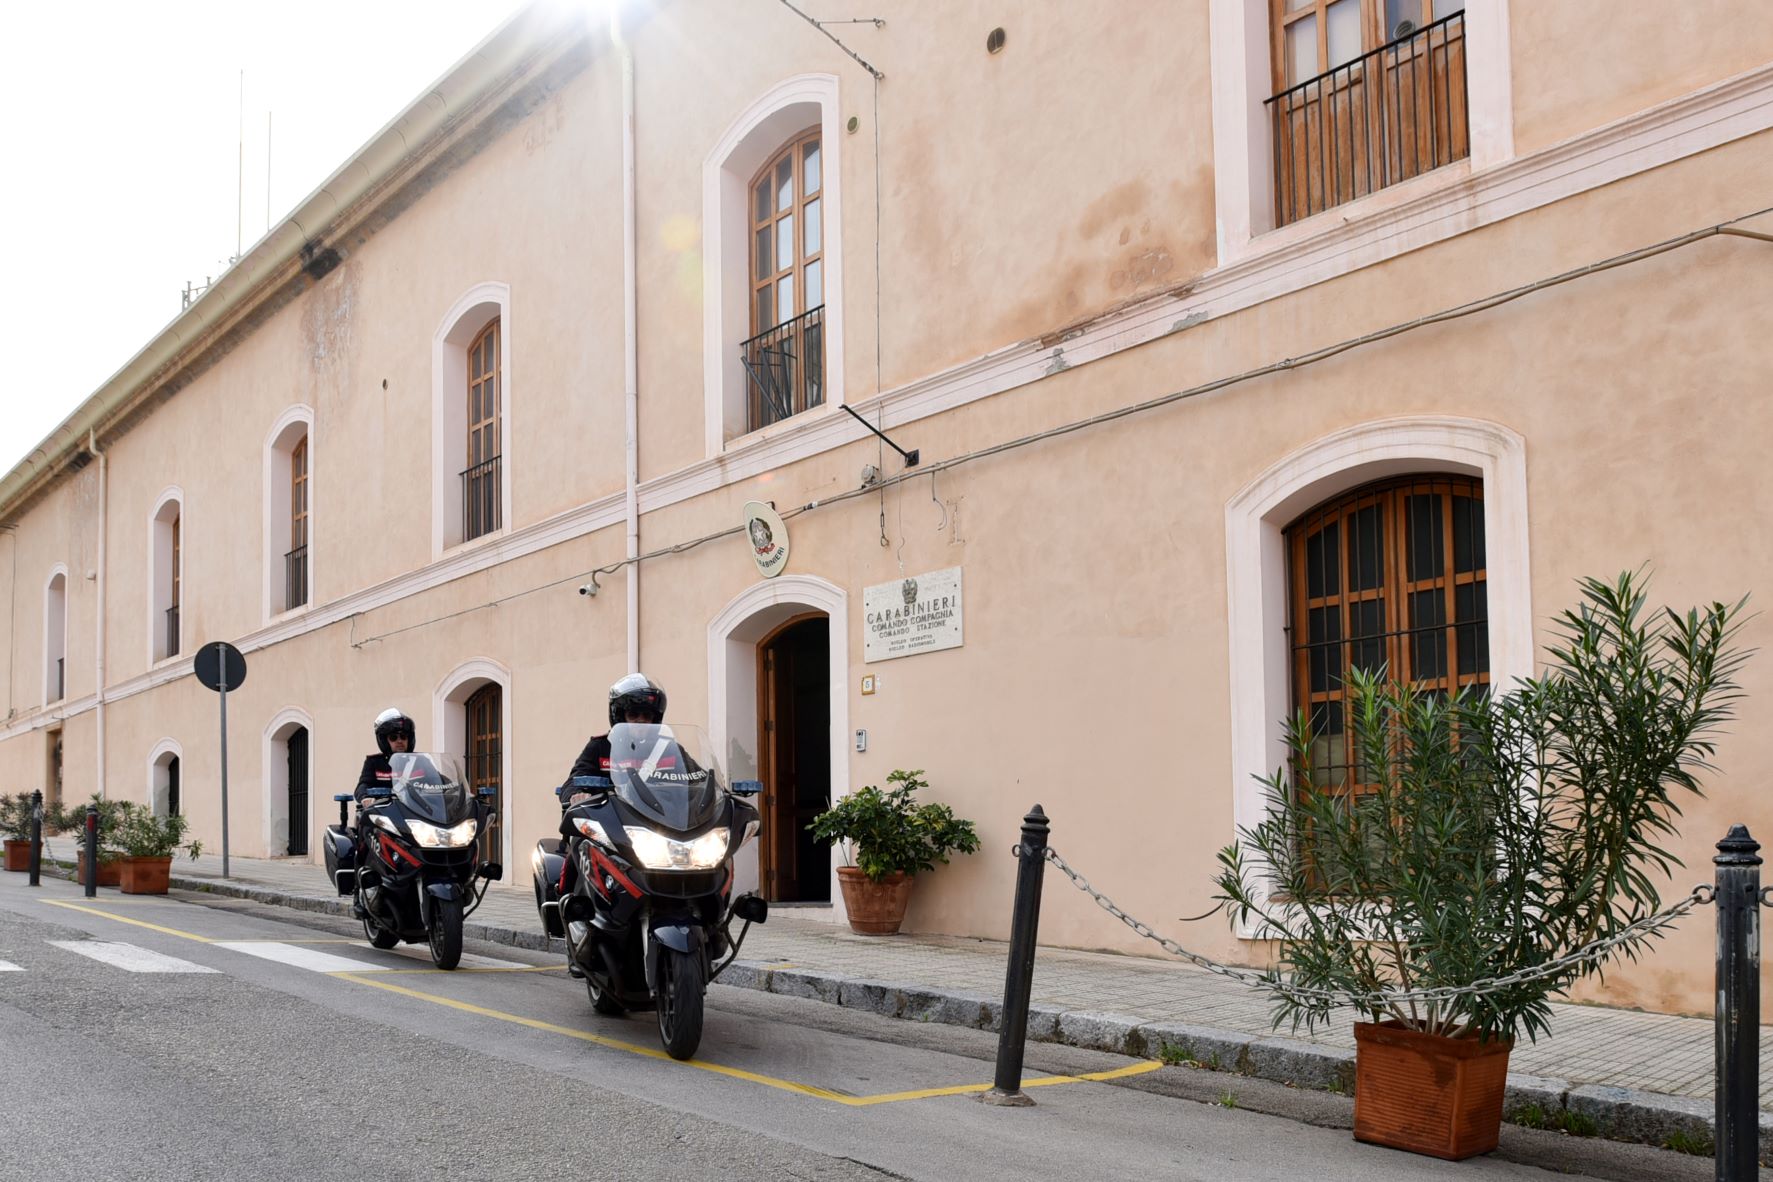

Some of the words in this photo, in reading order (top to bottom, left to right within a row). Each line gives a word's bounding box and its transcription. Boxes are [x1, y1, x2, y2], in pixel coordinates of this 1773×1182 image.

[755, 547, 784, 567] RABINIERI
[867, 595, 955, 624] CARABINIERI
[872, 619, 907, 632] COMANDO
[910, 608, 953, 624] COMPAGNIA
[879, 627, 909, 638] COMANDO
[917, 620, 946, 631] STAZIONE
[648, 770, 706, 780] ARABINIERI
[371, 836, 380, 857] 112
[579, 851, 590, 881] 112
